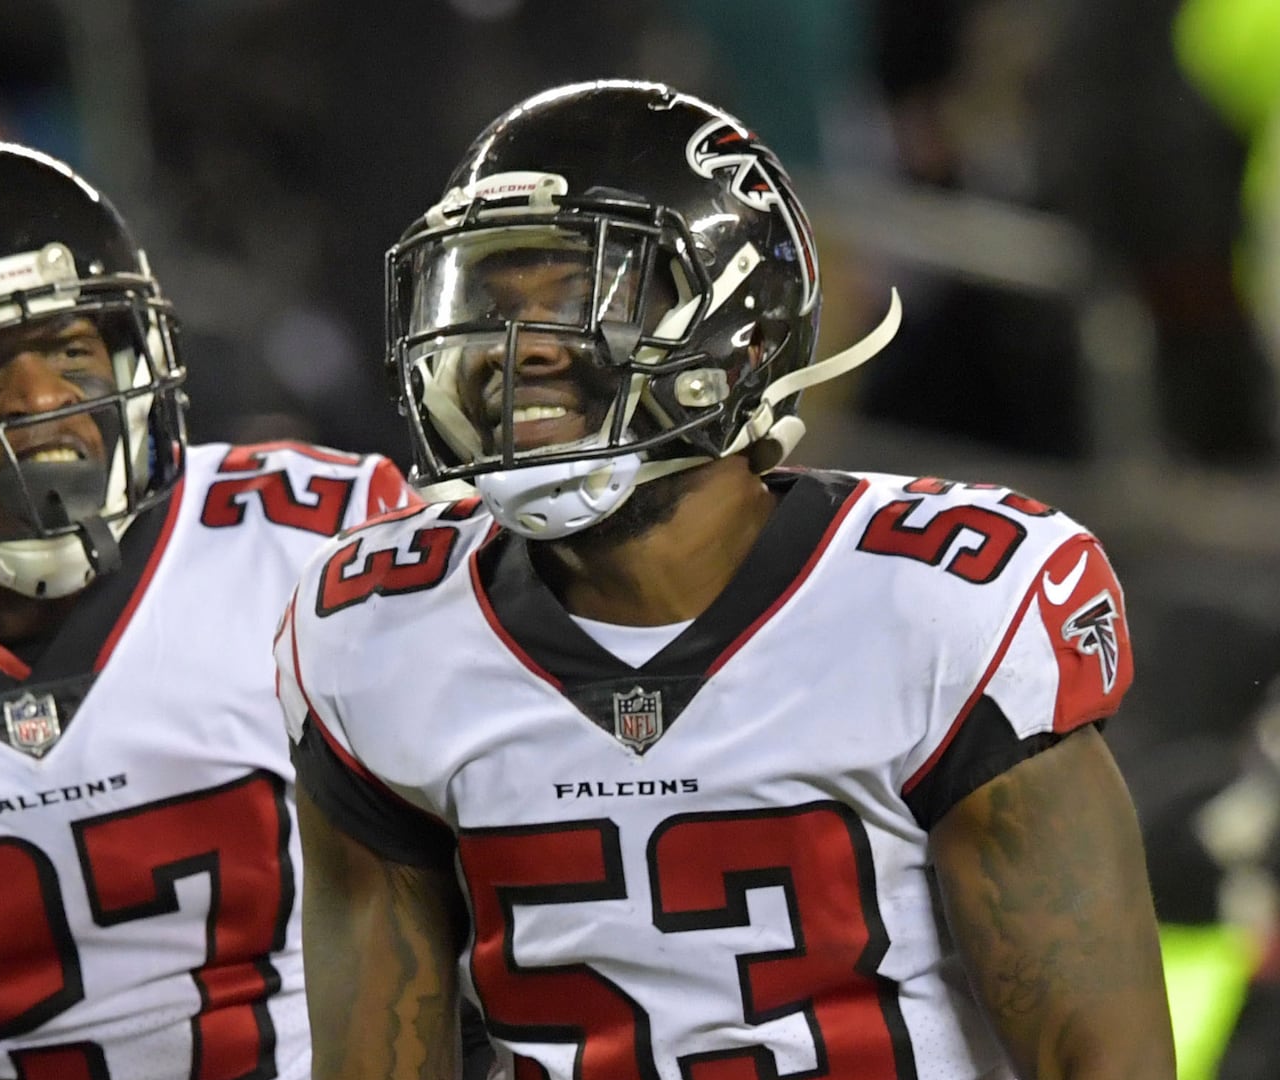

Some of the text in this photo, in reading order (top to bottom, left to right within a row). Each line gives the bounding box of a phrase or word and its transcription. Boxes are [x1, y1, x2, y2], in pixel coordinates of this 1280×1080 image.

[856, 476, 1058, 585] 5
[623, 714, 654, 739] NFL
[553, 778, 699, 799] FALCONS
